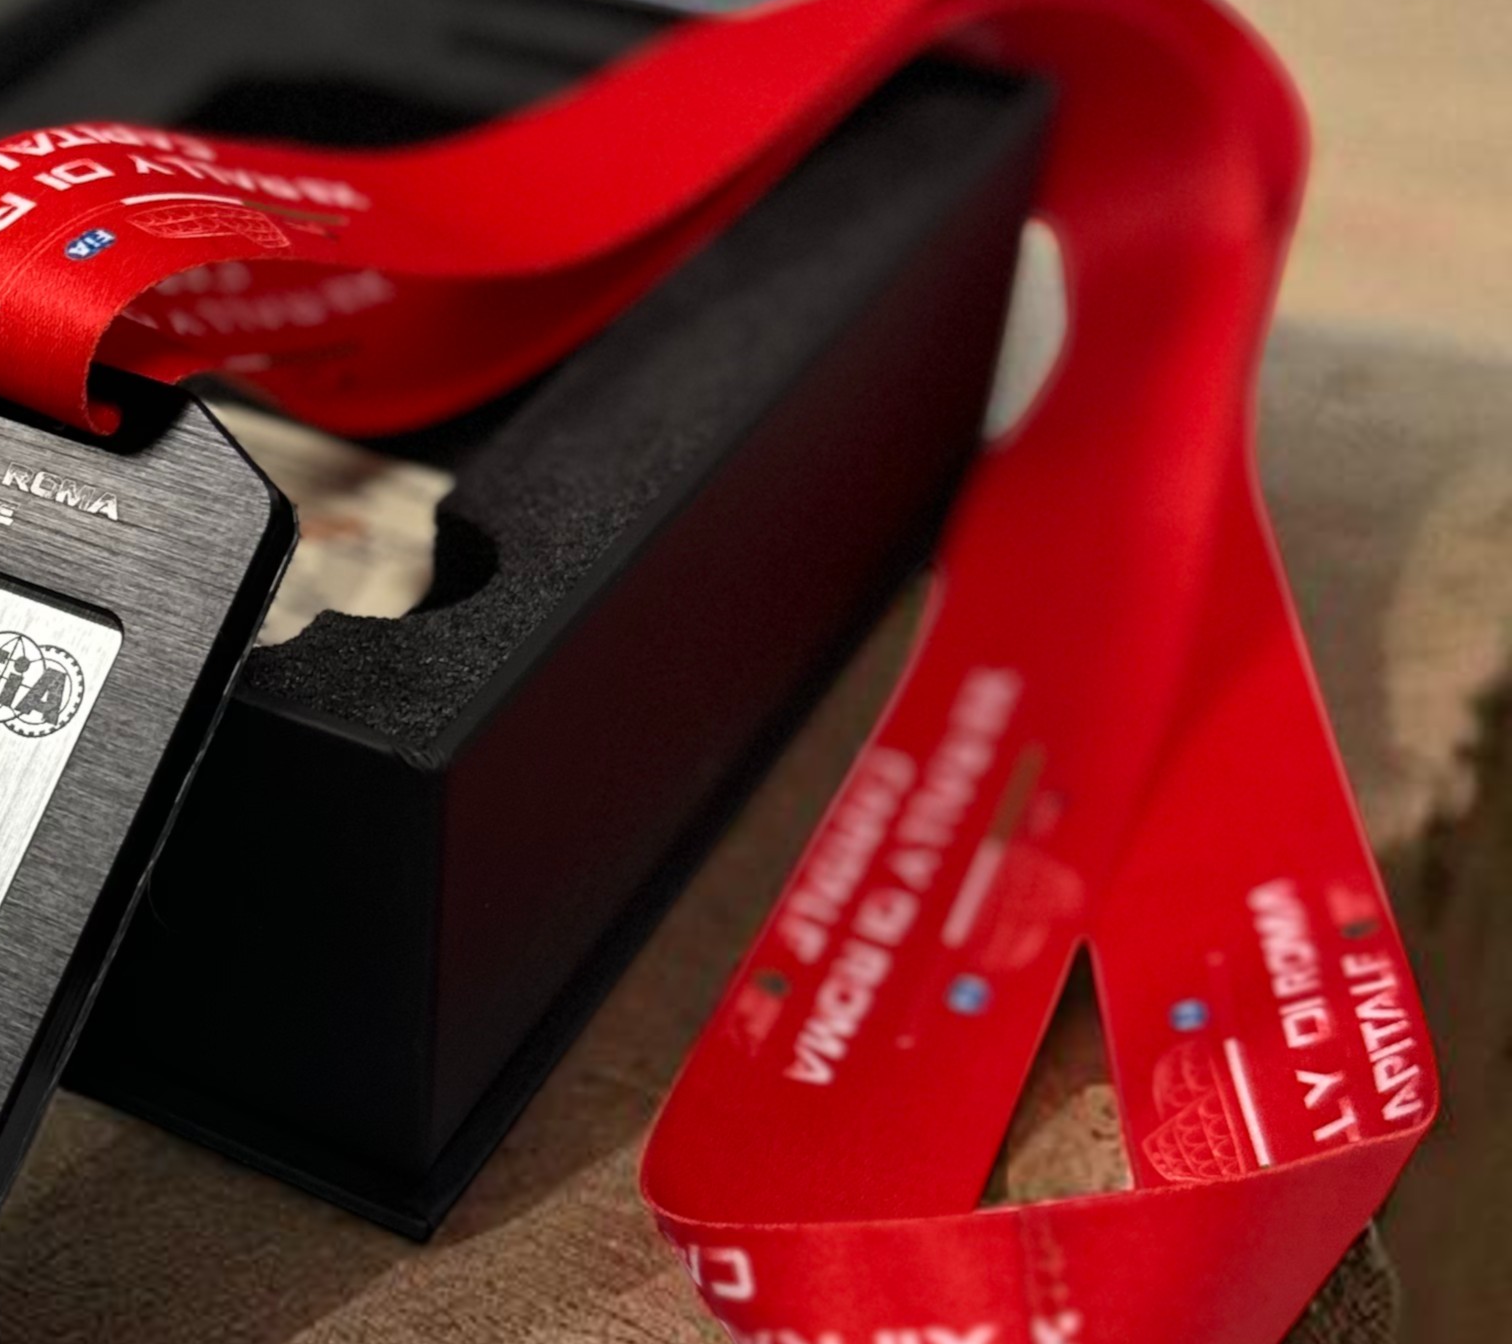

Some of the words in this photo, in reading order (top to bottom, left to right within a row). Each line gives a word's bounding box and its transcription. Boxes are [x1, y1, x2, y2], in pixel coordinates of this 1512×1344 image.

[33, 158, 115, 191] DI
[1, 461, 119, 521] ROMA
[1278, 997, 1334, 1049] DI
